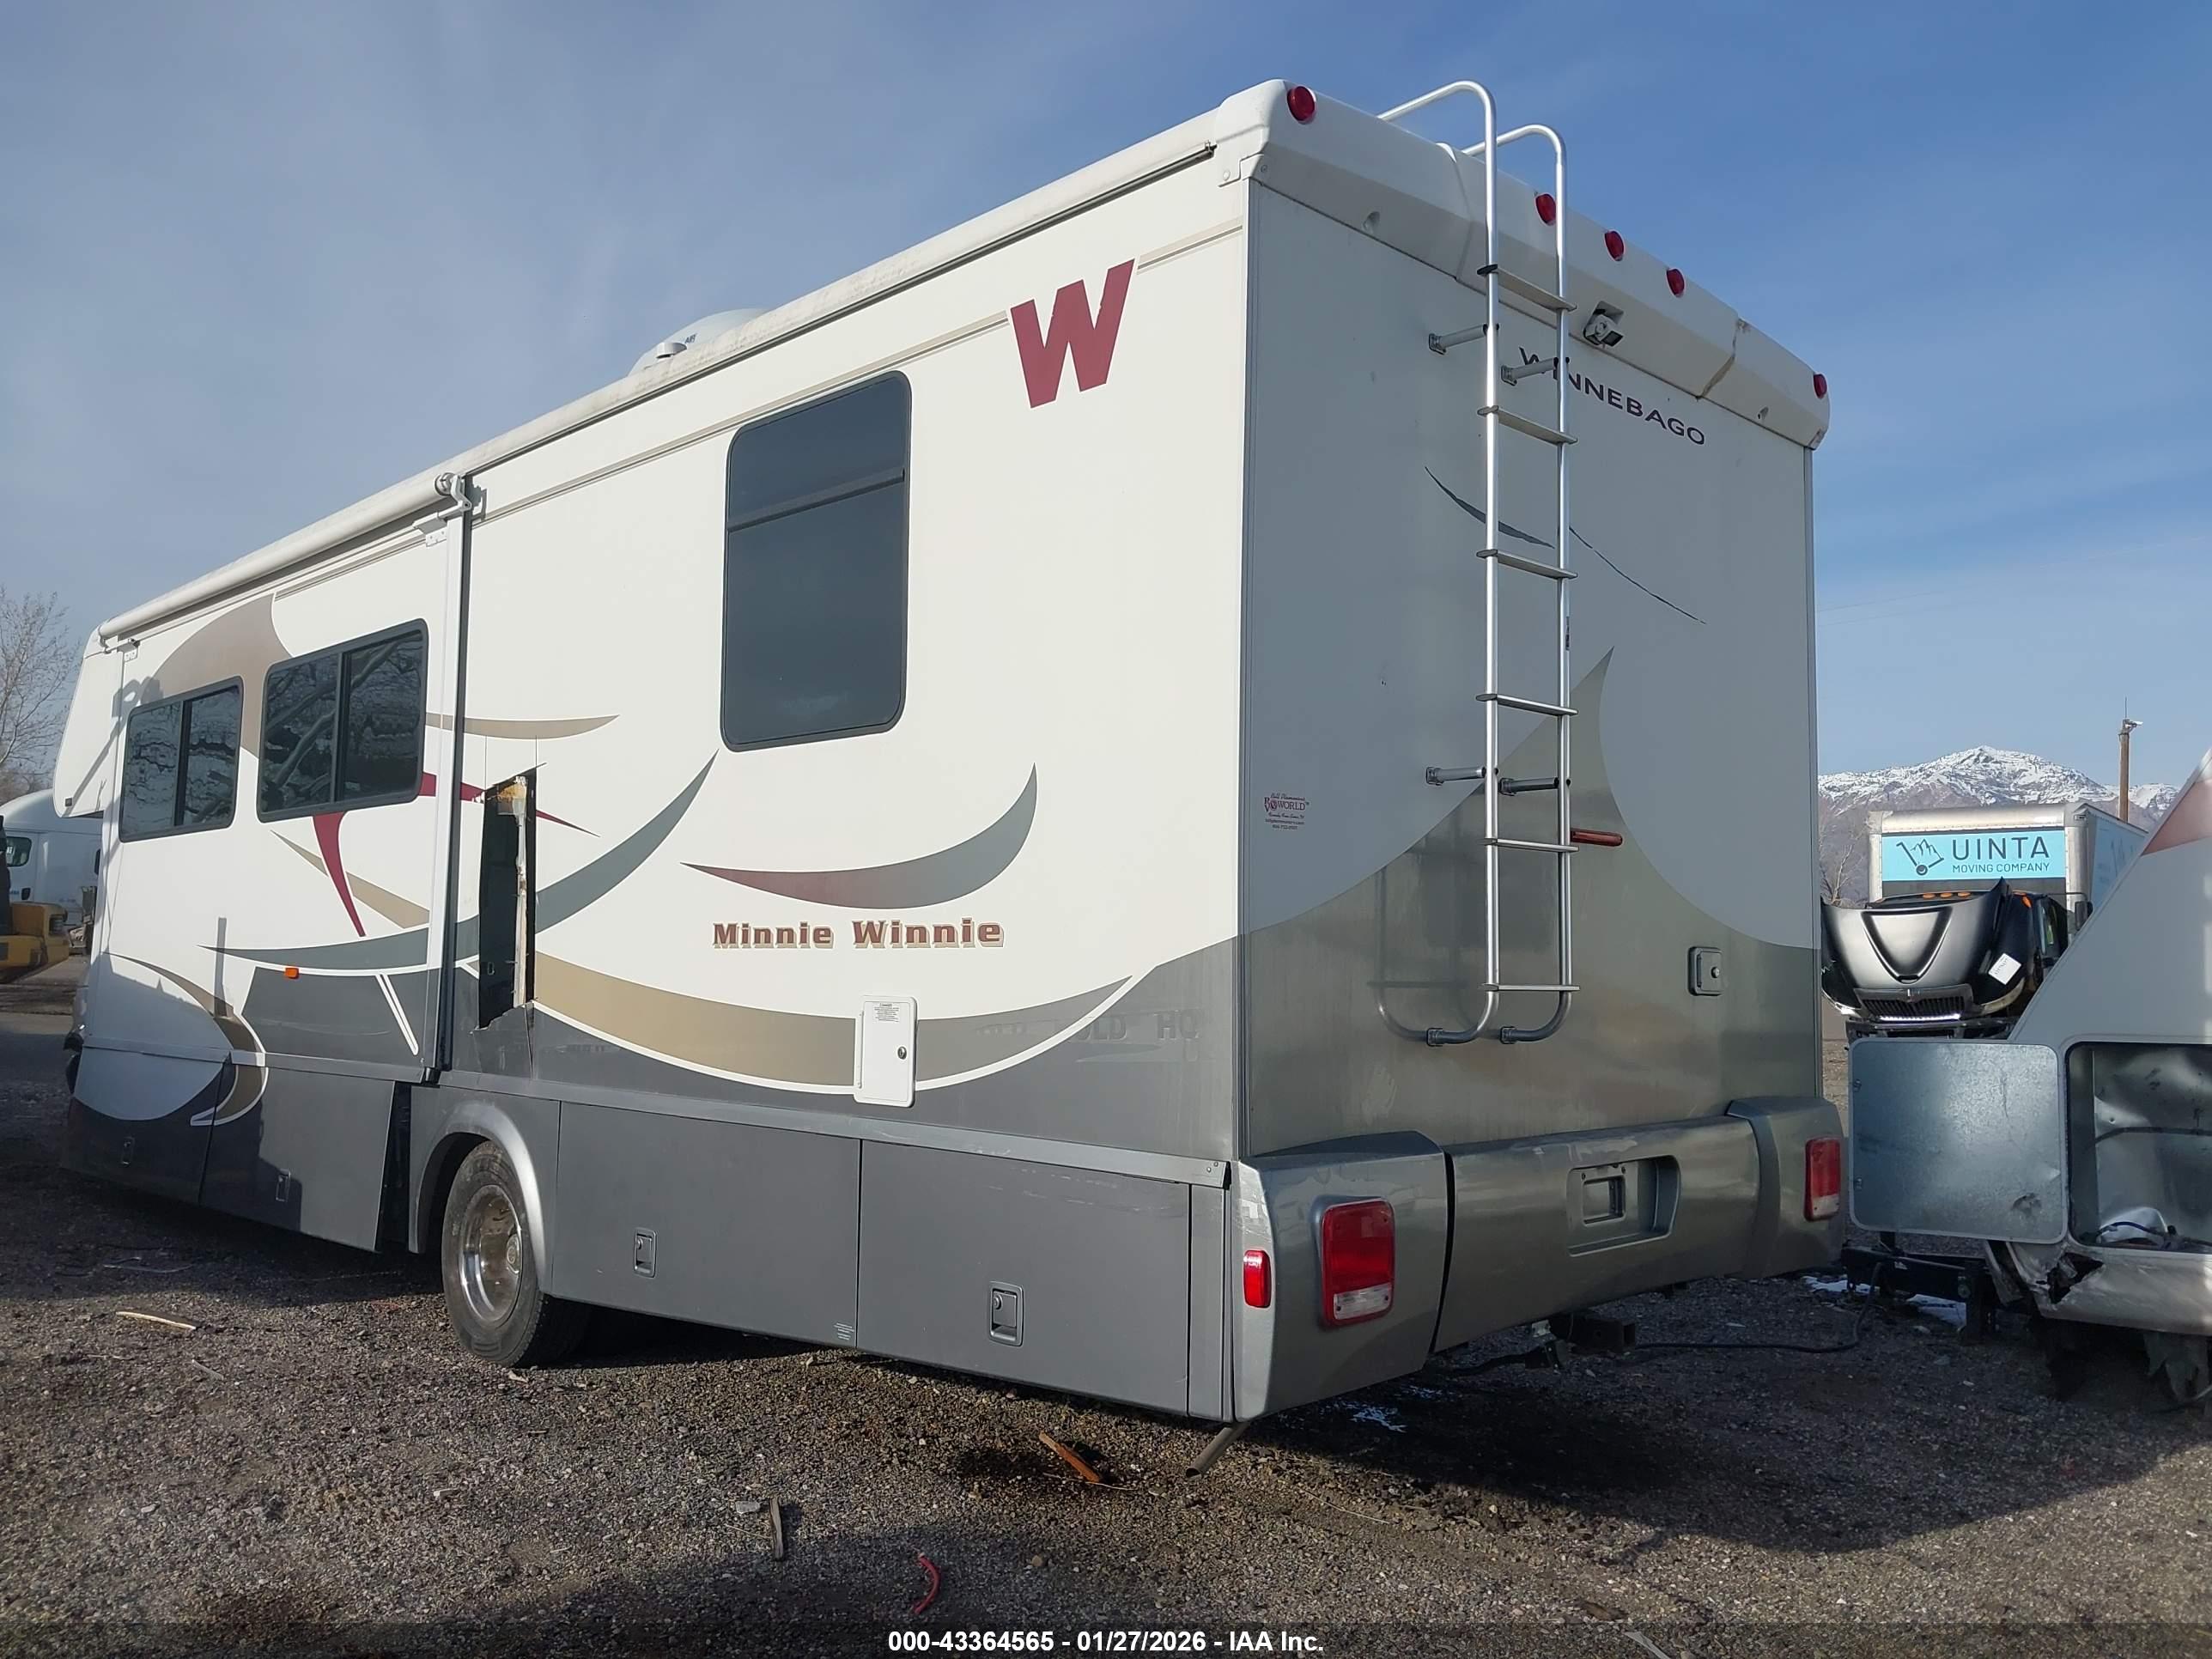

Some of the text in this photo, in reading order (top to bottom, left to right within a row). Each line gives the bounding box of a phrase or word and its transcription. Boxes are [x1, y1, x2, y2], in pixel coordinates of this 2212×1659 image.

[1010, 258, 1135, 409] W
[1518, 346, 1705, 445] WNNEBAGO
[1278, 800, 1305, 811] WORLD
[1952, 836, 2050, 860] UINTA
[1952, 862, 2050, 873] MOVING COMPANY
[714, 917, 1004, 949] Minnie Winnie
